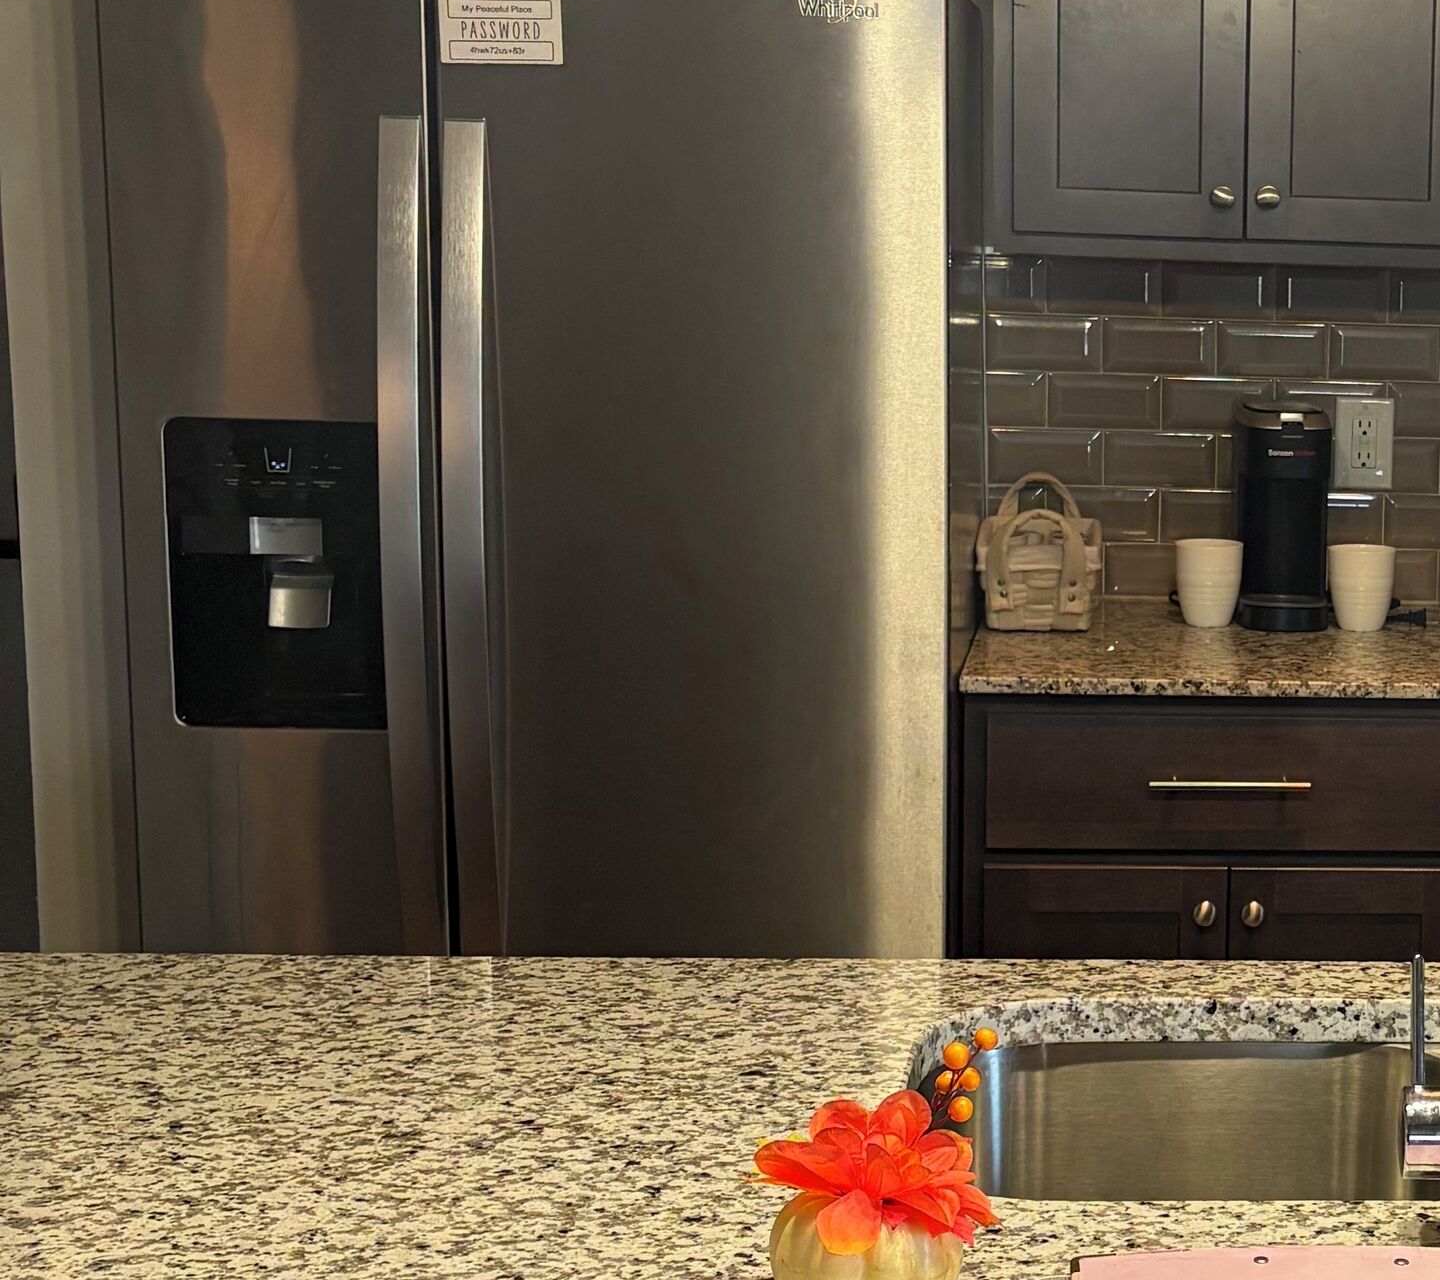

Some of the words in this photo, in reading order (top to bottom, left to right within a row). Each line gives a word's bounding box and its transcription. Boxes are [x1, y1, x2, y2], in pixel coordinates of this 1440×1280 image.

[462, 5, 473, 13] My
[476, 5, 509, 13] Peaceful
[511, 5, 532, 13] Place
[461, 20, 540, 40] PASSWORD
